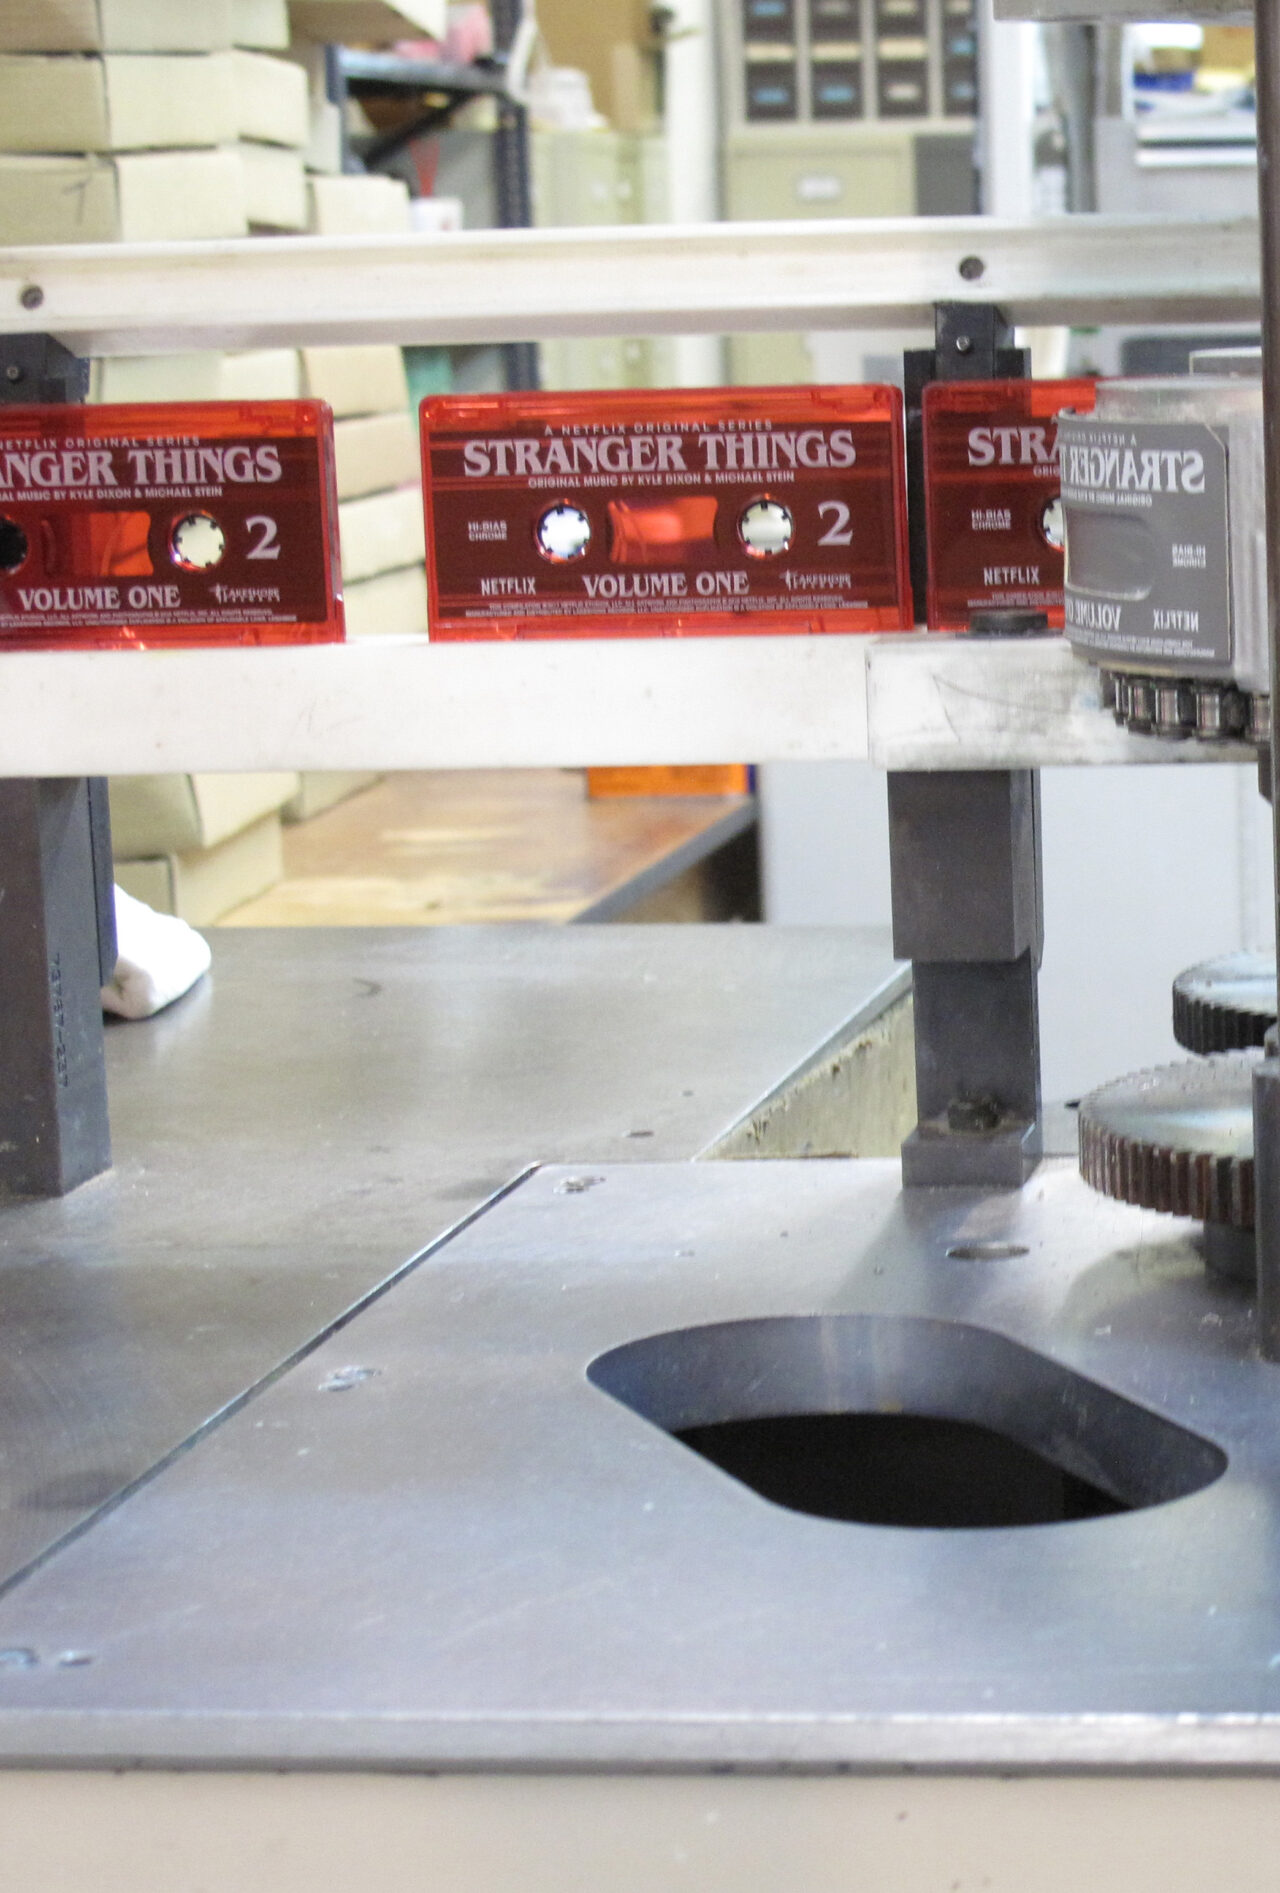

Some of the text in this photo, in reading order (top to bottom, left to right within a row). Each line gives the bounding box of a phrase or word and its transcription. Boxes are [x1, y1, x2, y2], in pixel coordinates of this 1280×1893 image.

[544, 418, 773, 437] A NETFLIX ORIGINAL SERIES
[65, 436, 140, 449] ORIGINAL
[147, 435, 200, 447] SERIES
[463, 429, 857, 477] STRANGER THINGS
[0, 445, 283, 489] NGER THINGS
[528, 471, 795, 489] ORIGINAL MUSIC BY KYLE DIXON & MICHAEL STEIN
[54, 489, 67, 500] BY
[97, 487, 131, 499] DIXON
[145, 486, 193, 498] MICHAEL
[195, 485, 223, 497] STEIN
[817, 501, 854, 546] 2
[246, 515, 281, 560] 2
[480, 577, 537, 596] NETFLIX
[582, 570, 750, 599] VOLUME ONE
[983, 566, 1040, 587] NETFLIX
[18, 585, 181, 611] VOLUME ONE
